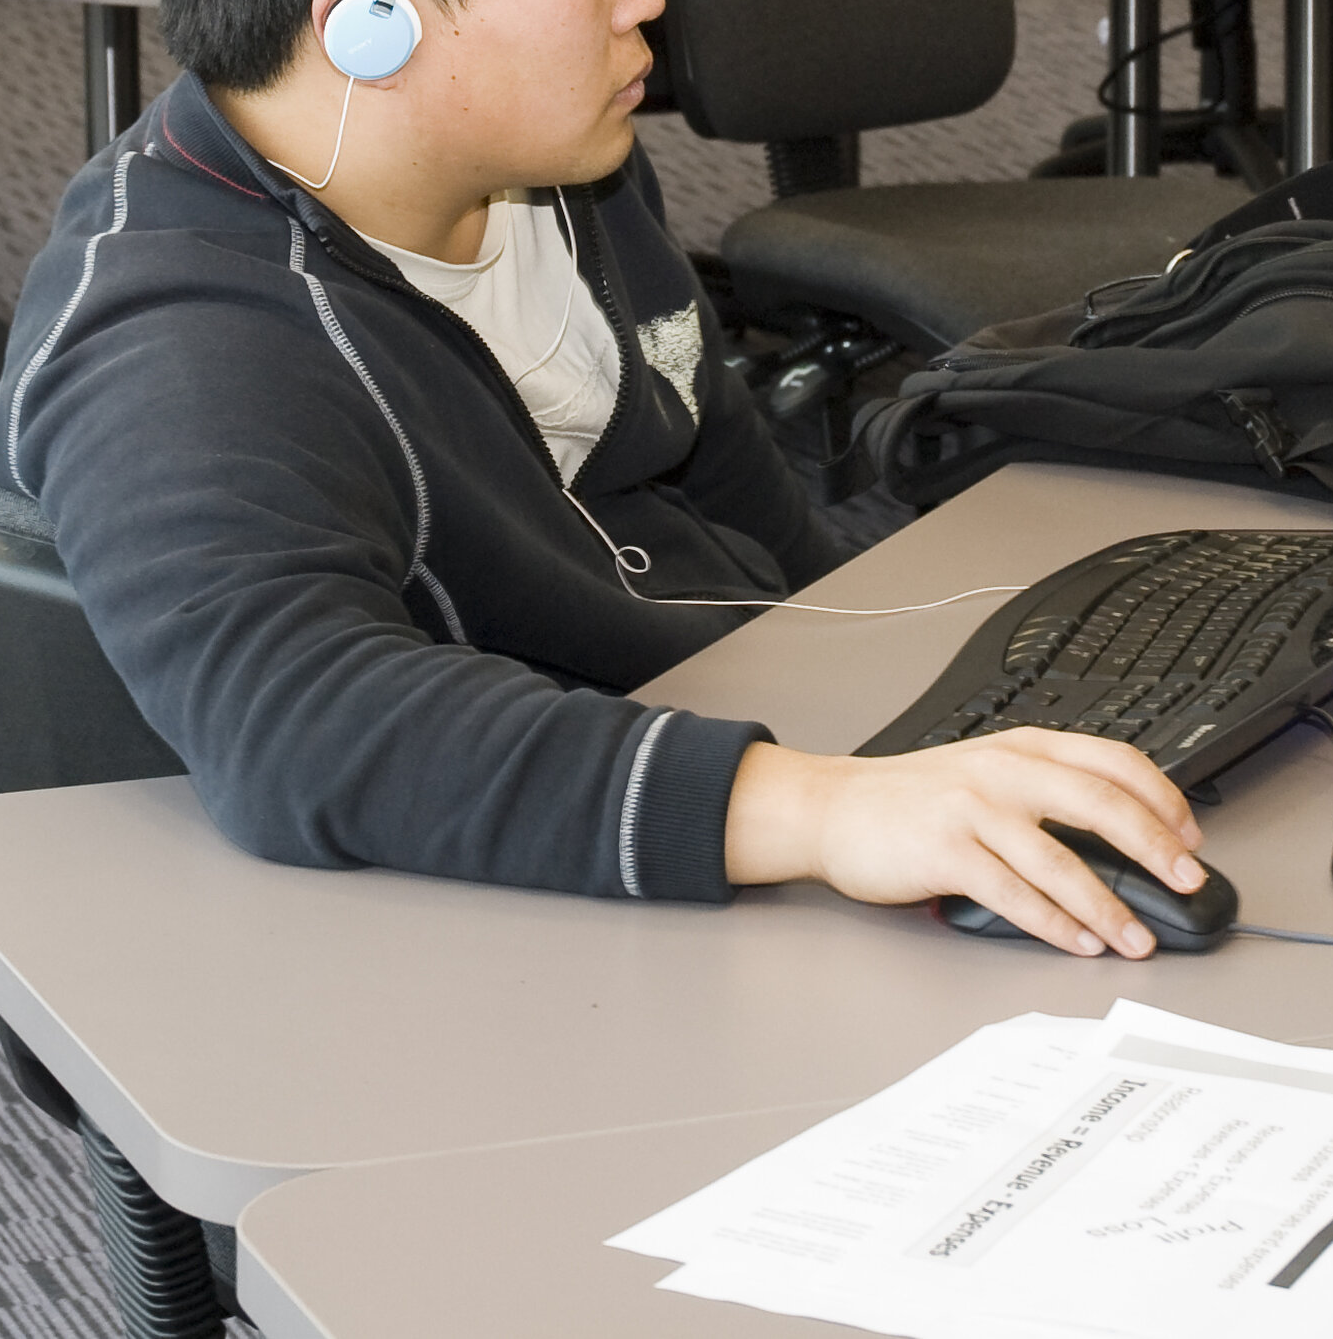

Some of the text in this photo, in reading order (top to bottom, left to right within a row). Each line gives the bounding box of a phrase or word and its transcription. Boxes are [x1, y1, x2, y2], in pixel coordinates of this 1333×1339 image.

[1080, 1078, 1148, 1123] Income
[1006, 1138, 1083, 1191] Revenue
[929, 1199, 1013, 1257] Expenses
